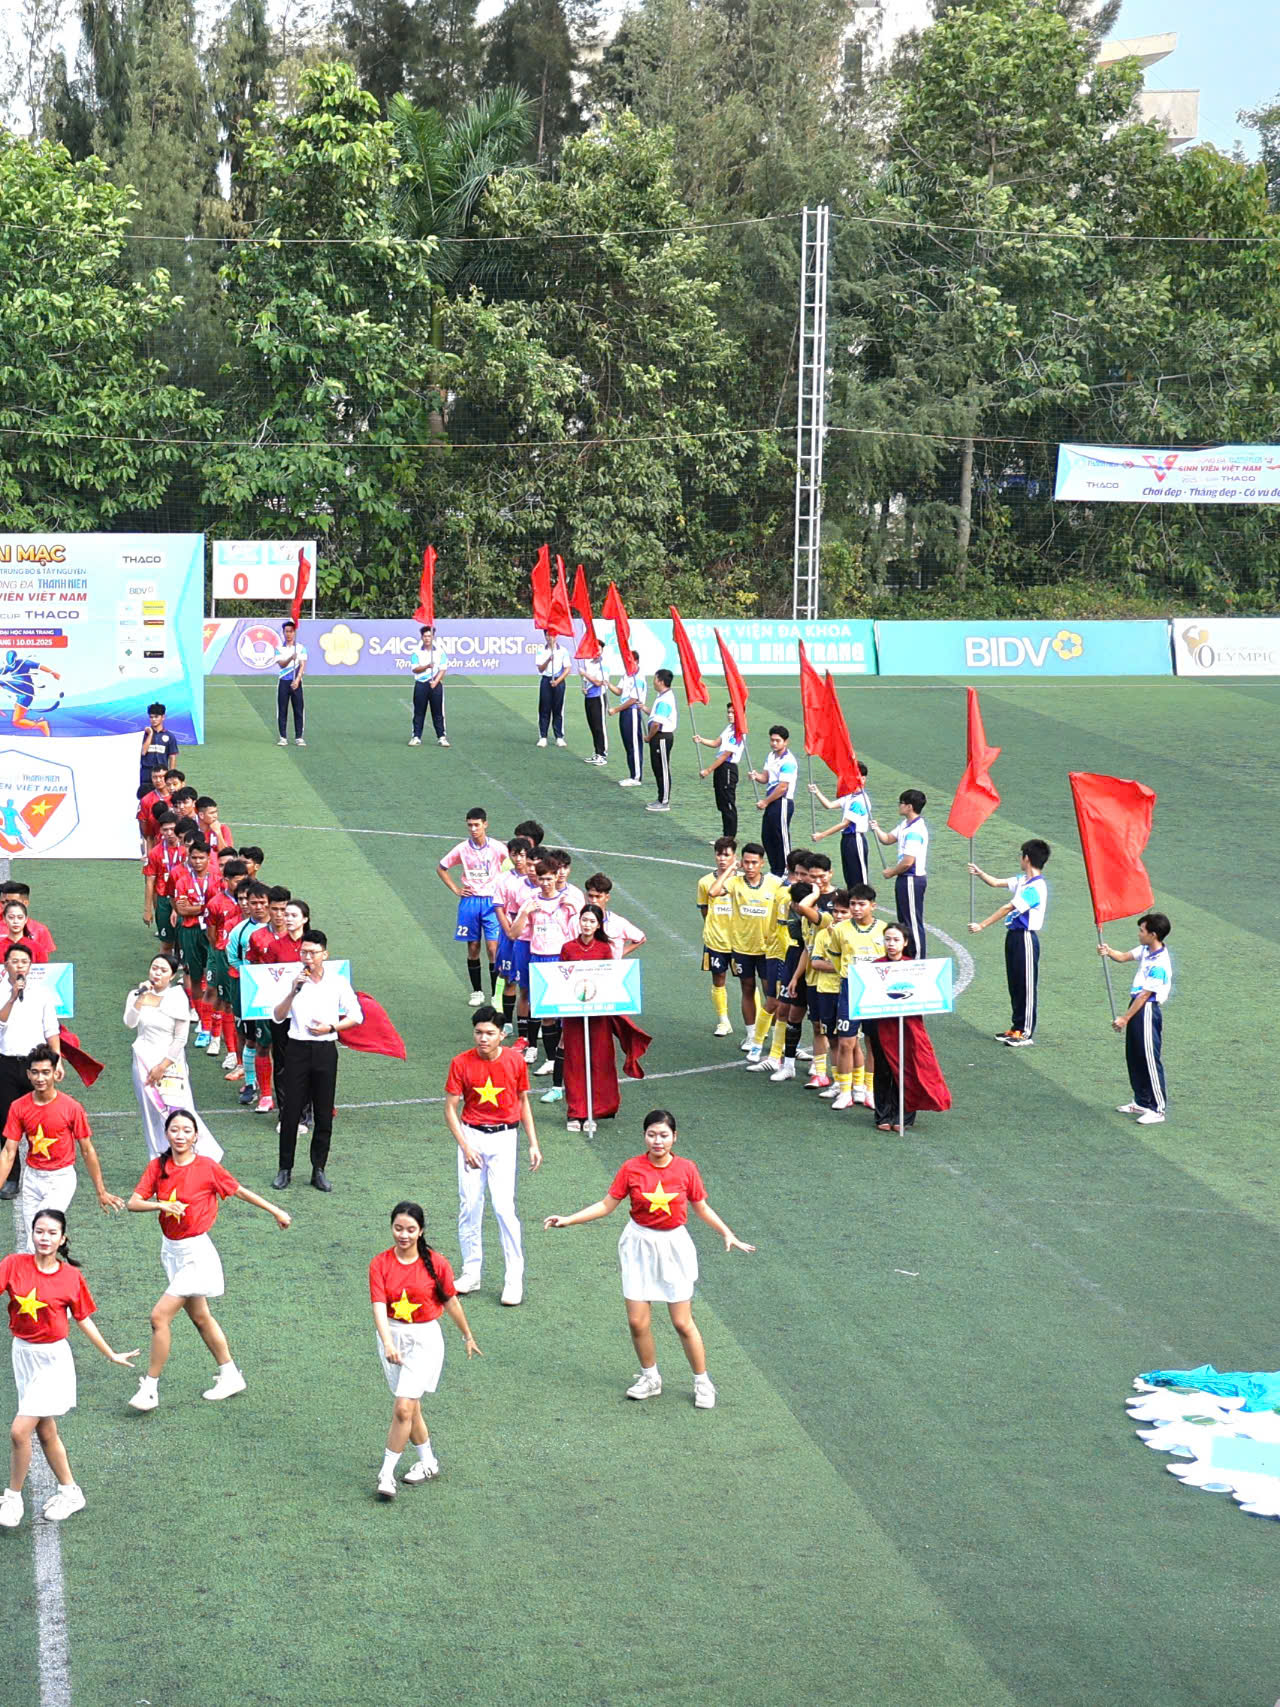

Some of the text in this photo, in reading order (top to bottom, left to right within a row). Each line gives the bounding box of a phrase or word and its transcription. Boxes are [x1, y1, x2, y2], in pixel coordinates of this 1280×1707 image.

[16, 545, 66, 566] MẠC
[122, 556, 162, 564] THACO
[233, 572, 248, 595] 0
[280, 572, 295, 595] 0
[59, 592, 87, 601] NAM
[25, 610, 80, 620] THACO
[735, 623, 773, 640] VIỆN
[777, 625, 803, 638] ĐA
[805, 624, 852, 638] KHOA
[16, 638, 53, 646] 10.01.2025
[369, 636, 526, 655] SAIGNTOURIST
[965, 636, 1052, 667] BIDV
[743, 906, 766, 914] THACO
[161, 928, 167, 937] 6
[457, 926, 468, 936] 22
[502, 960, 511, 970] 13
[711, 957, 721, 968] 14
[207, 971, 212, 981] 8
[218, 985, 223, 995] 5
[837, 1019, 849, 1032] 20
[256, 1028, 262, 1038] 3
